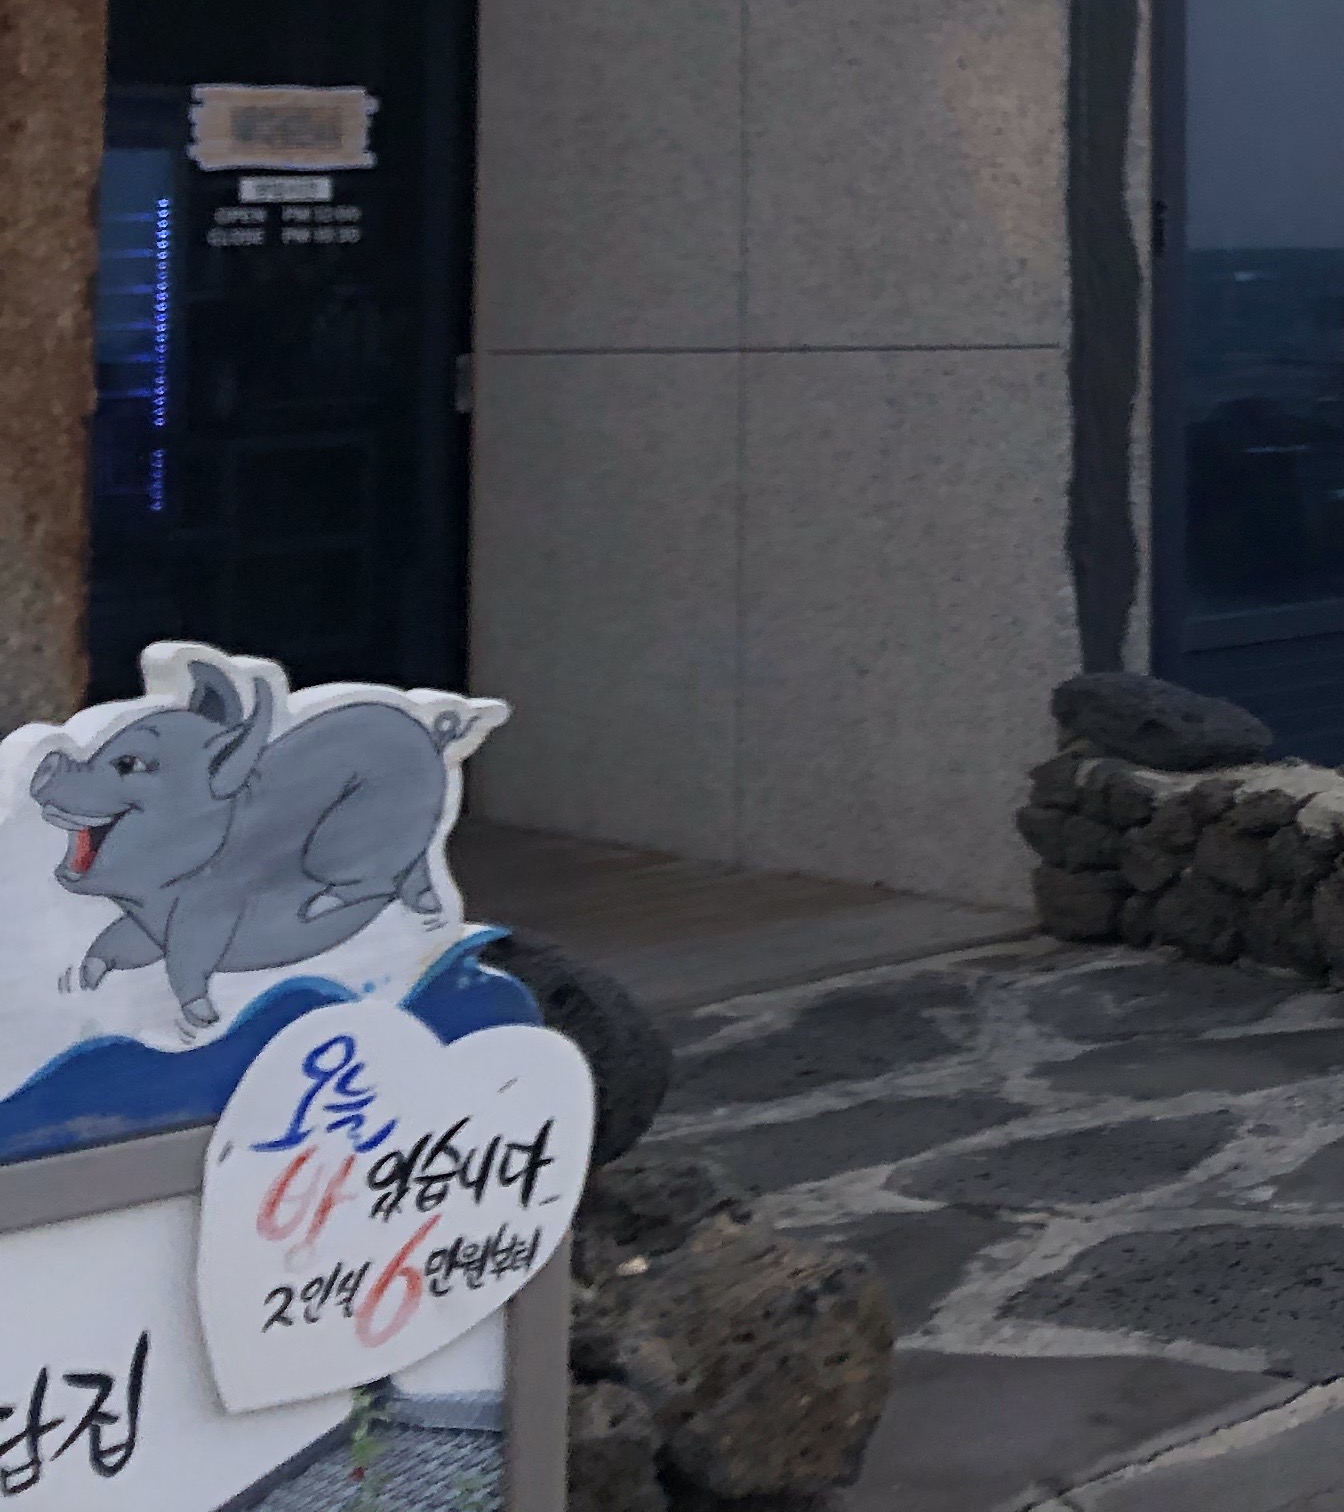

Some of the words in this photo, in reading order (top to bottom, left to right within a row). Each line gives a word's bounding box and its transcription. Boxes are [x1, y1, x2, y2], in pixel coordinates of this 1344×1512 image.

[249, 1034, 399, 1154] 오늘
[255, 1143, 359, 1275] 방
[366, 1114, 555, 1223] 있습니다
